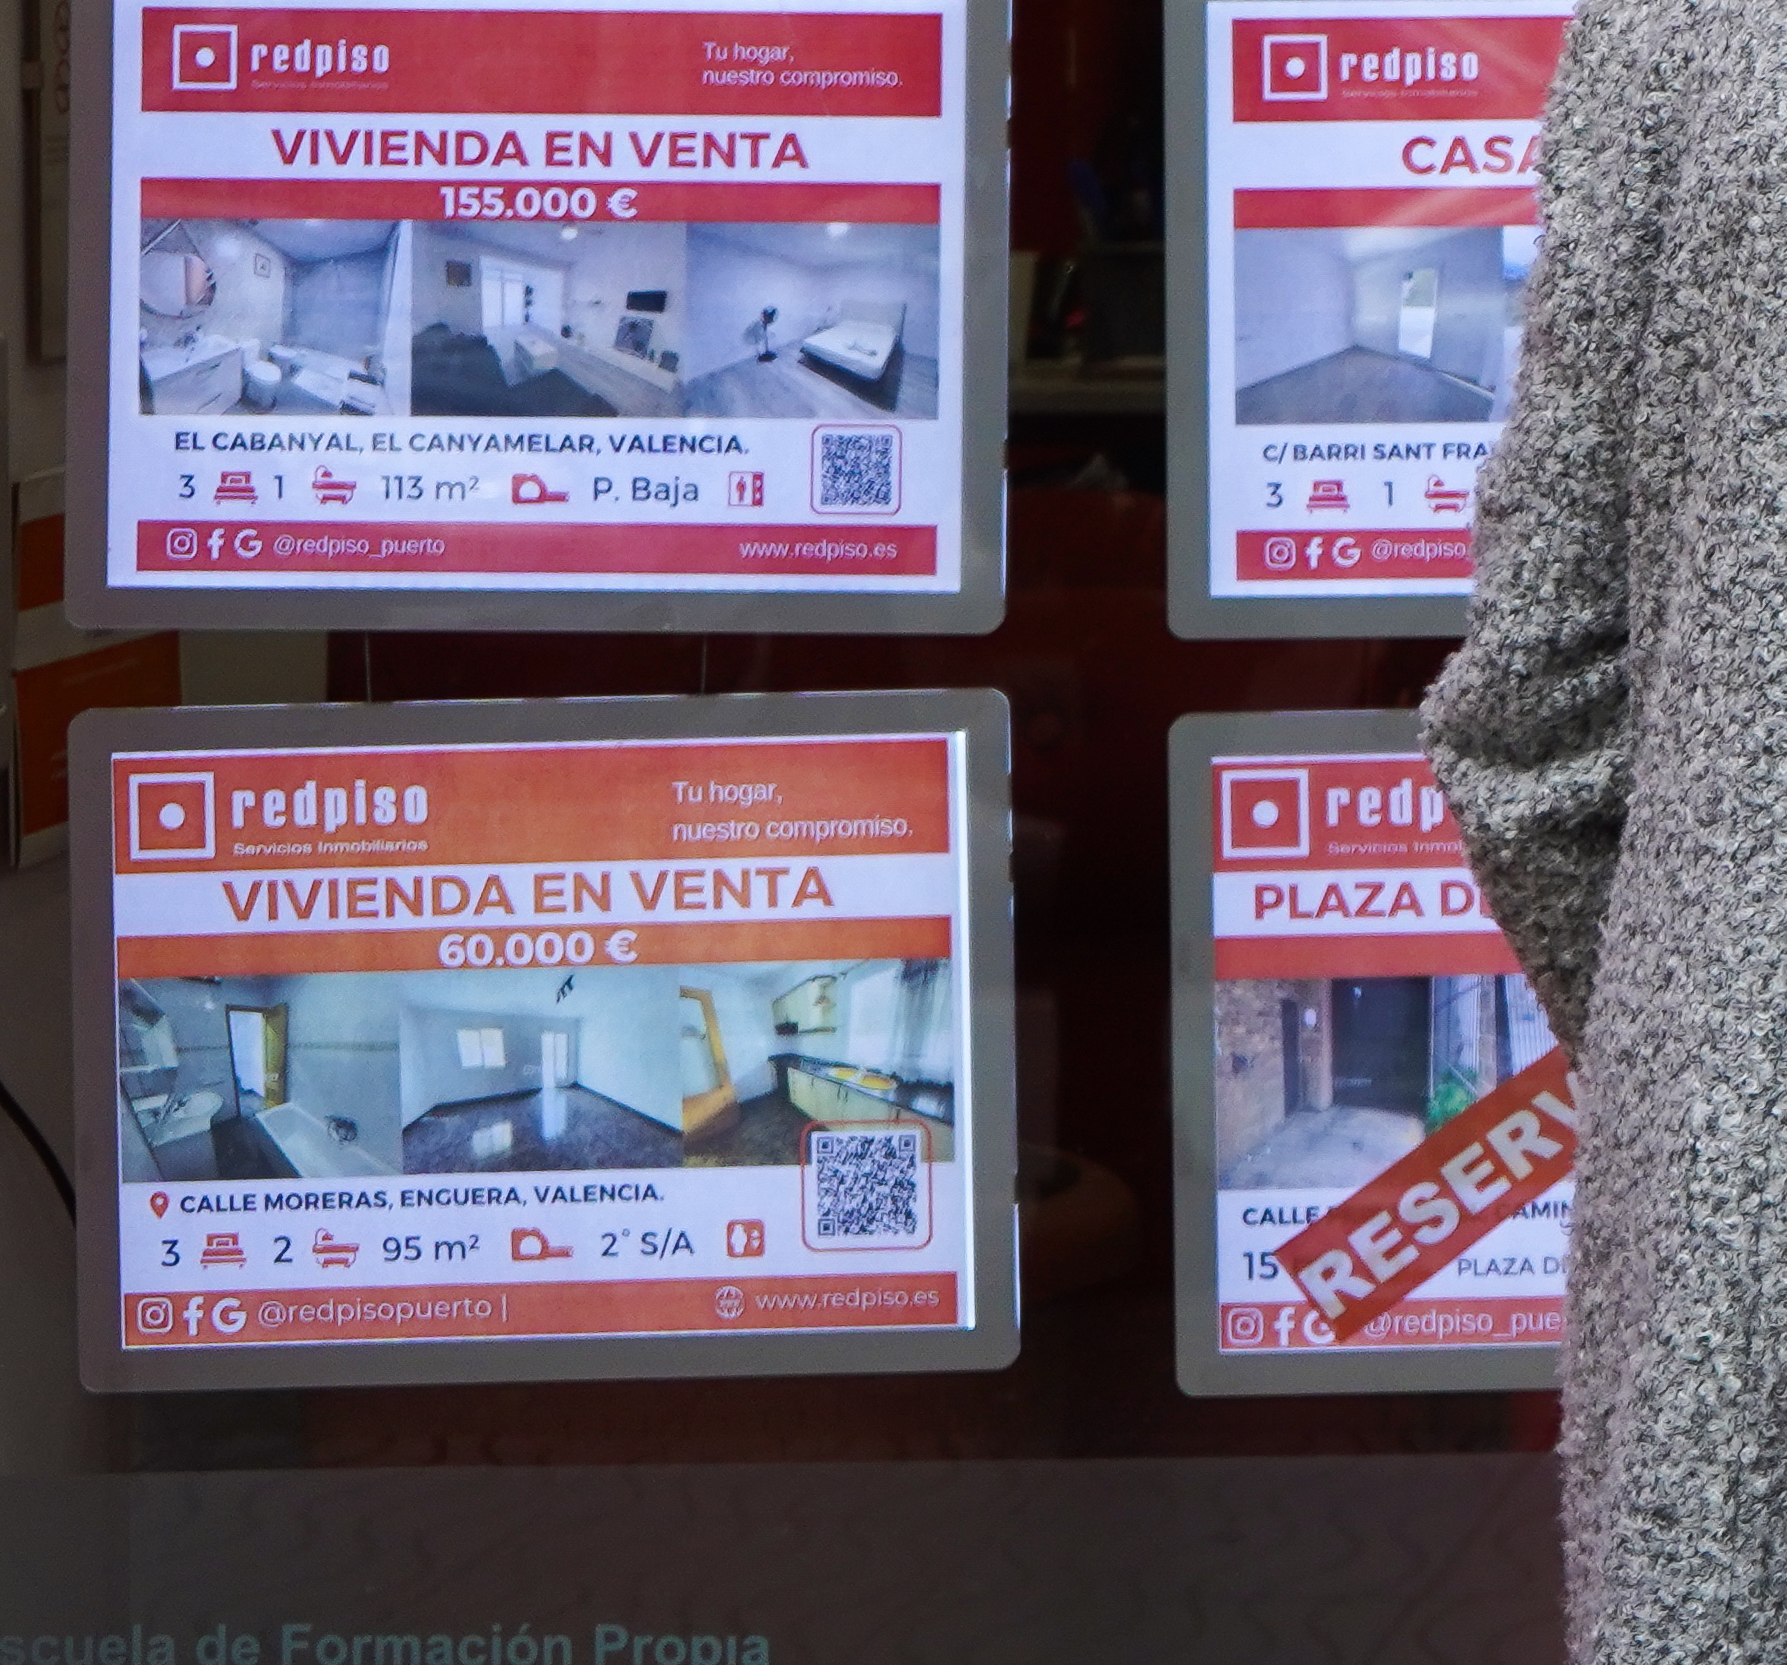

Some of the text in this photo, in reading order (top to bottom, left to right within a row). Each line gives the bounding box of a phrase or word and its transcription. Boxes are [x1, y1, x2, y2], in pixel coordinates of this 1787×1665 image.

[271, 128, 809, 169] VIVIENDA EN VENTA
[440, 186, 638, 219] 155.000 €
[174, 430, 206, 452] EL
[372, 433, 401, 452] EL
[1292, 442, 1436, 462] BARRI SANT
[232, 779, 428, 830] redpiso
[221, 867, 836, 923] VIVIENDA EN VENTA
[1254, 881, 1424, 921] PLAZA
[438, 929, 640, 967] 60.000 €
[179, 1193, 257, 1214] CALLE
[257, 1297, 492, 1328] @redpisopuerto
[754, 1287, 939, 1311] www.redpiso.es
[0, 1624, 174, 1665] scuela
[196, 1624, 261, 1665] de
[282, 1622, 573, 1665] Formación
